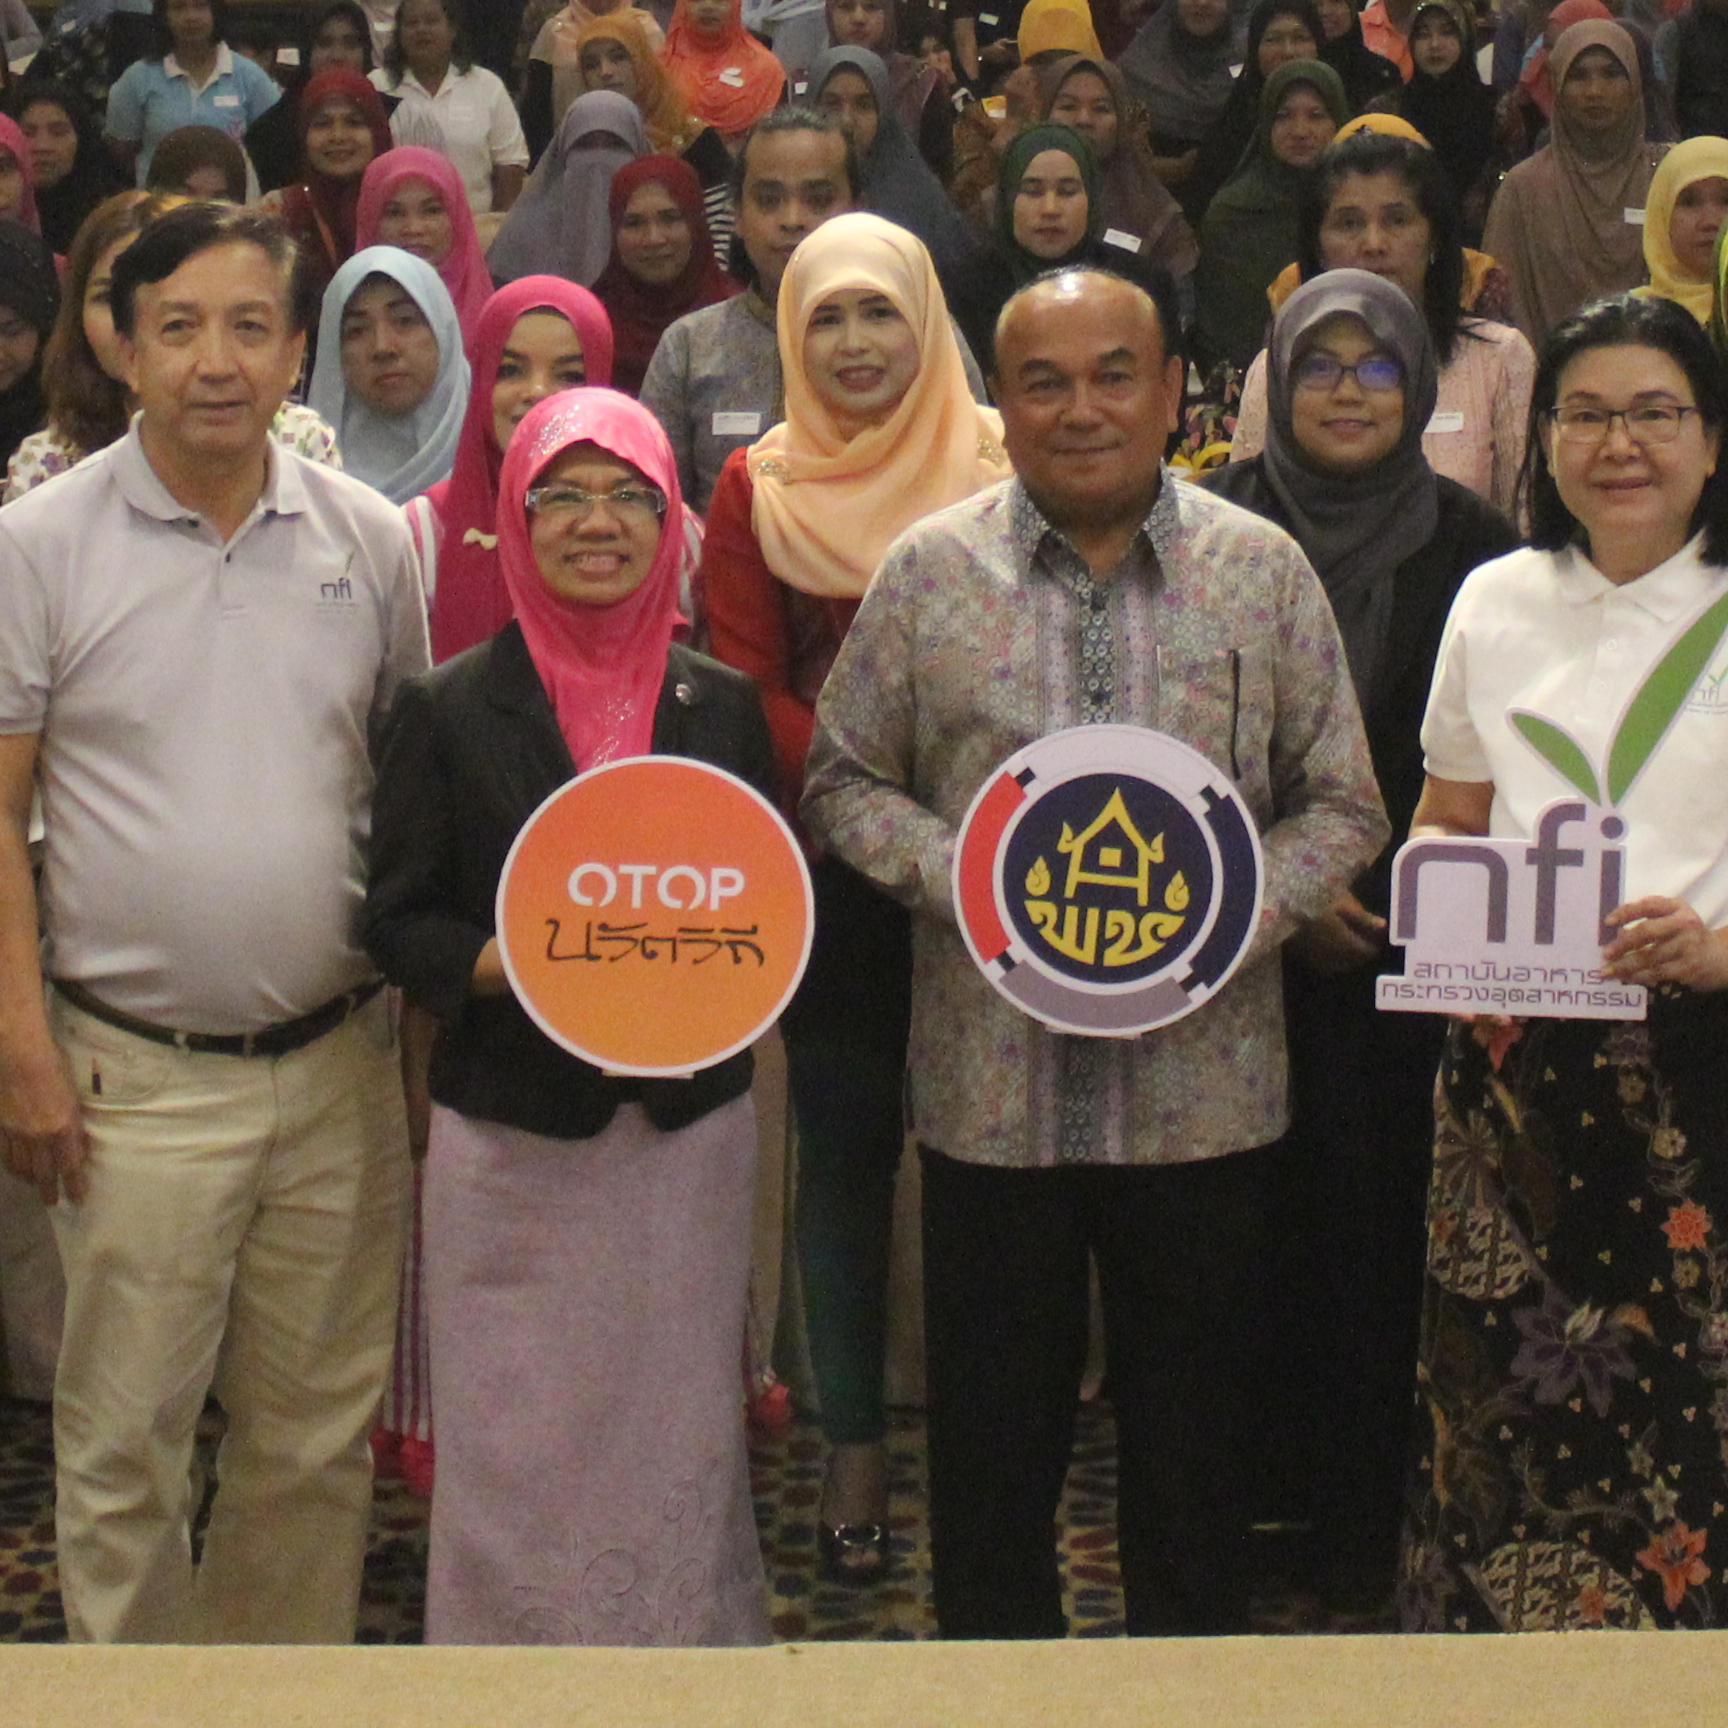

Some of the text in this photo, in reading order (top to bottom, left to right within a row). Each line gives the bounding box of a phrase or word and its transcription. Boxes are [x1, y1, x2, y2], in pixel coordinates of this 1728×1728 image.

[567, 862, 746, 911] OTOP
[1397, 803, 1624, 947] nfi
[1413, 961, 1604, 985] สถาบันอาหาร
[1382, 982, 1642, 1008] กระทรวงอุตสาหกรรม
